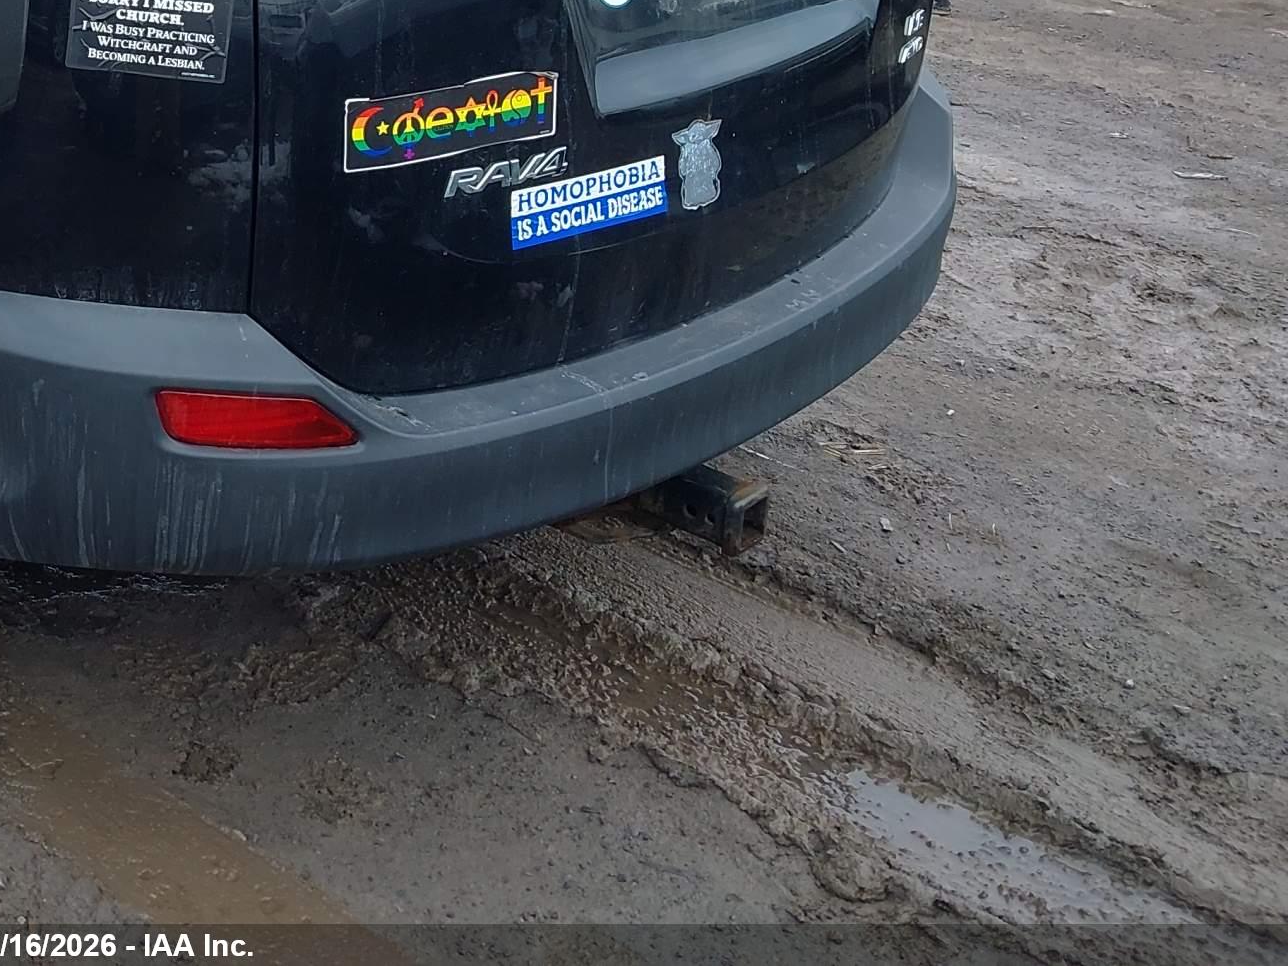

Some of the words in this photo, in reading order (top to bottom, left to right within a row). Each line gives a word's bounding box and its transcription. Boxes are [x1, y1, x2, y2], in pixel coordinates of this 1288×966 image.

[81, 20, 89, 31] I
[115, 8, 185, 26] CHURCH.
[147, 53, 156, 65] A
[173, 45, 198, 56] AND
[444, 146, 568, 198] RAV4
[518, 161, 661, 212] HOMOPHOBIA
[517, 218, 532, 241] IS
[535, 215, 549, 236] A
[551, 201, 605, 232] SOCIAL
[607, 186, 663, 219] DISEASE
